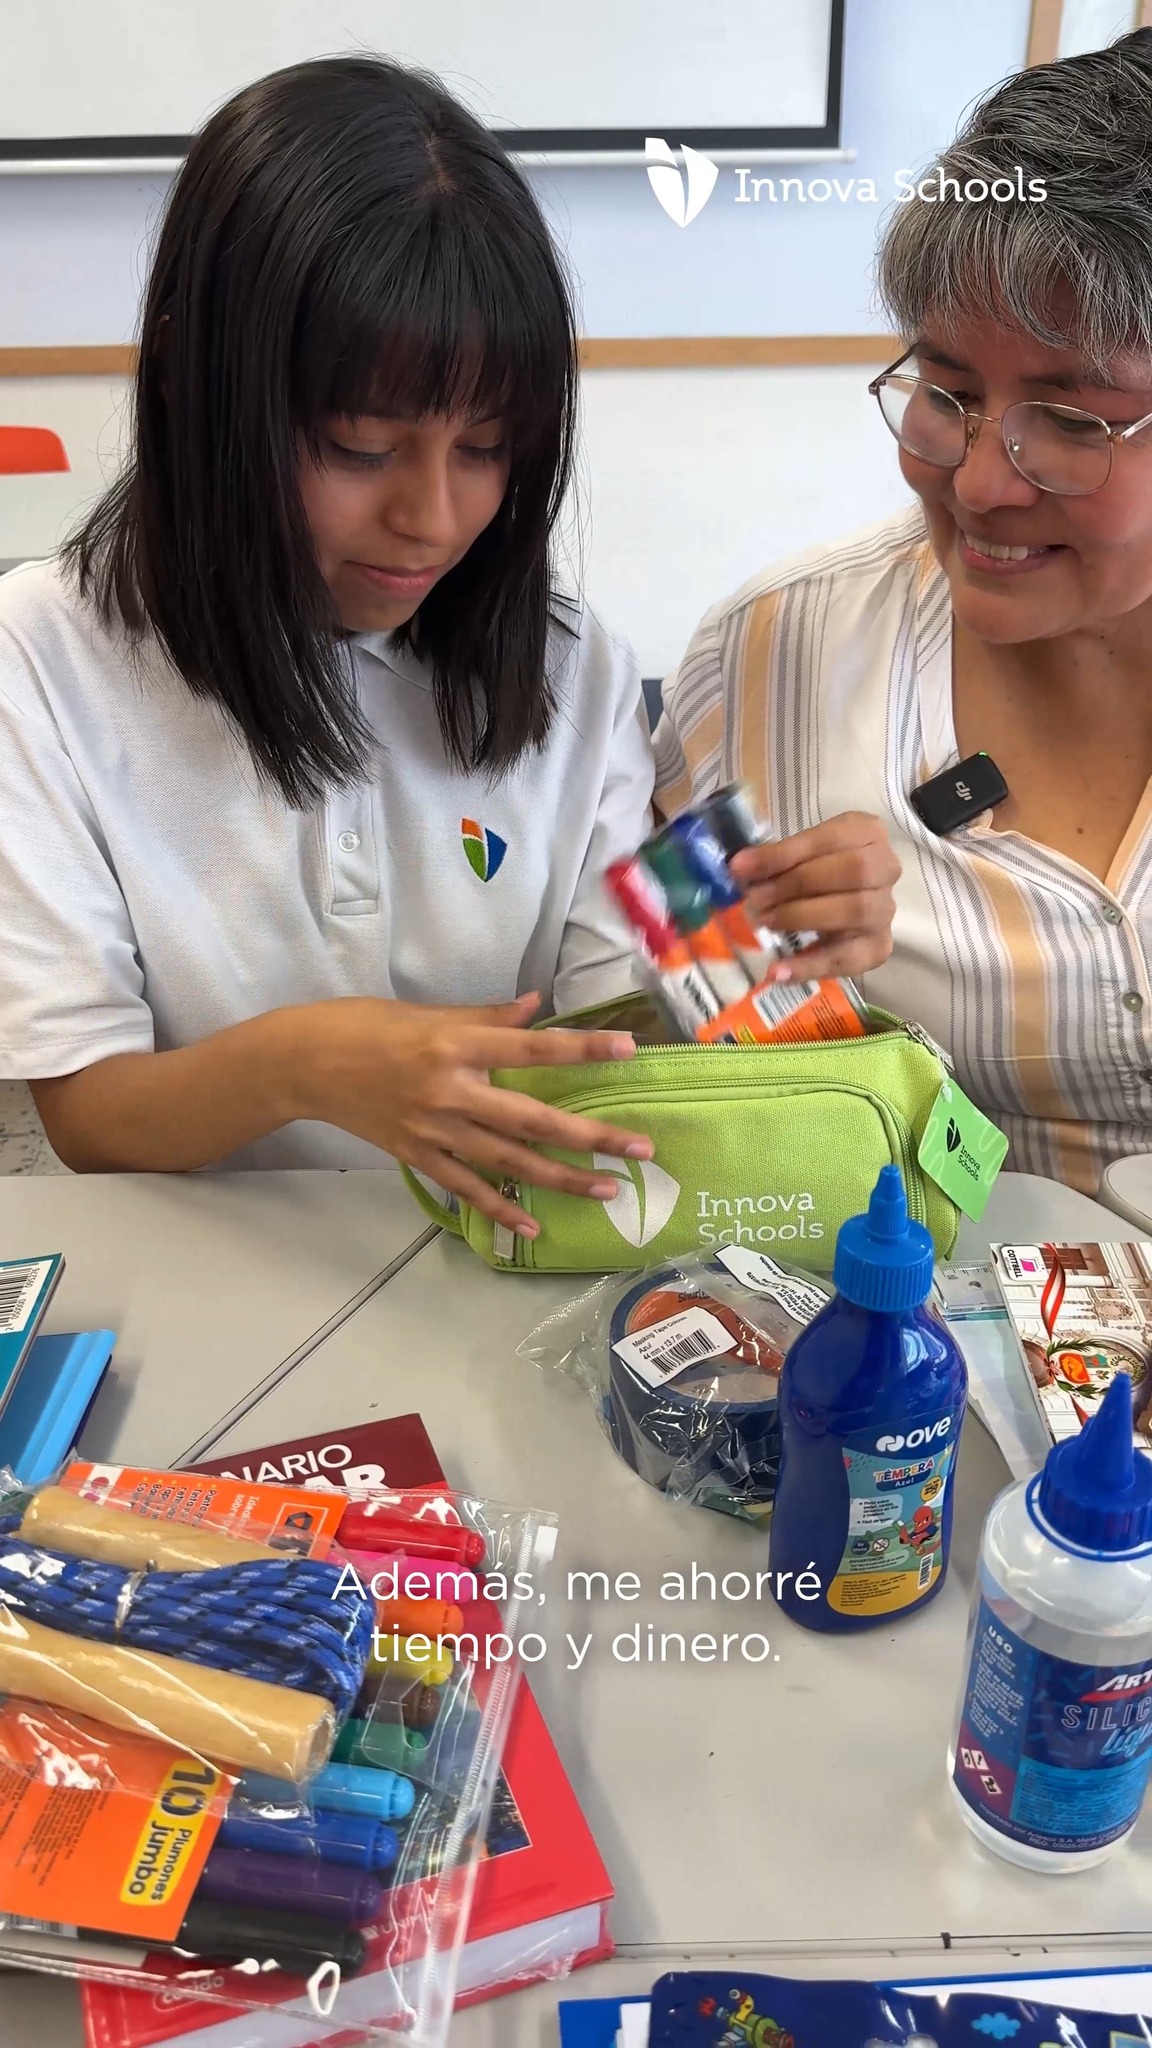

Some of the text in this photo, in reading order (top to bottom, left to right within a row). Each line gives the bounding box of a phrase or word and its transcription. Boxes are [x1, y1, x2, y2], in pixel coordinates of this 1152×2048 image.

[957, 1154, 980, 1181] Schools
[961, 1145, 981, 1171] Innova
[697, 1191, 816, 1217] Innova
[699, 1215, 825, 1245] Schools
[1007, 1249, 1023, 1278] COTTBELL
[632, 1328, 656, 1347] Masking
[654, 1322, 669, 1336] Tape
[638, 1342, 653, 1354] Azul
[873, 1457, 935, 1482] TÉMPERA
[895, 1477, 914, 1487] Azul
[988, 1625, 1013, 1653] USO
[1061, 1696, 1152, 1731] SILIC
[161, 1767, 217, 1816] 10
